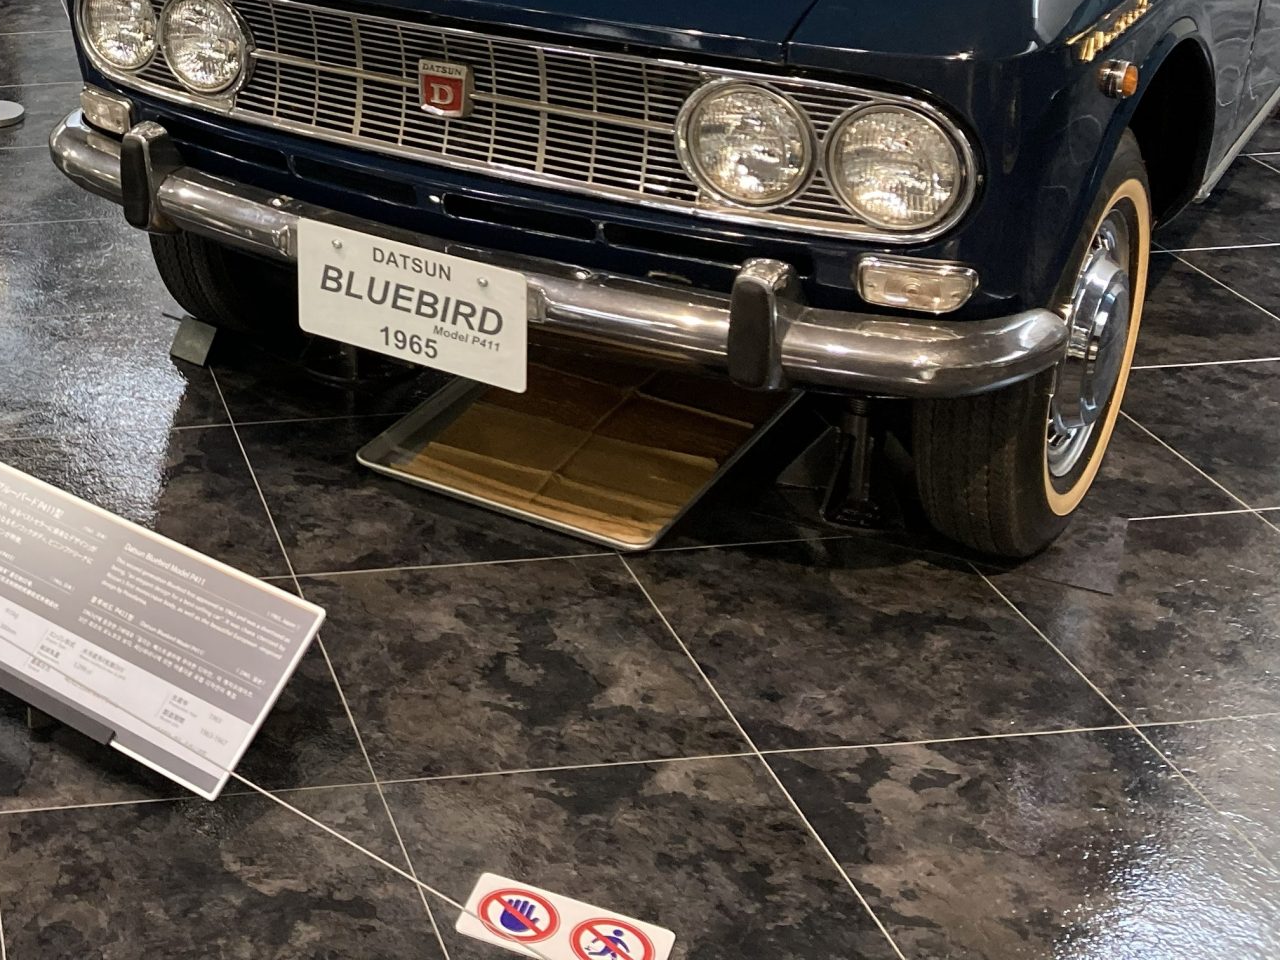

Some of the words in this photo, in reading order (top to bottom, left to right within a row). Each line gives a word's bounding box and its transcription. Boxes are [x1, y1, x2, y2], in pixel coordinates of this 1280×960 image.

[422, 62, 462, 76] DATSUN
[430, 83, 454, 105] D
[372, 247, 451, 281] DATSUN
[320, 264, 504, 336] BLUEBIRD
[379, 326, 438, 359] 1965
[433, 325, 468, 343] Model
[471, 336, 501, 352] P411
[122, 542, 147, 558] Datsun
[144, 552, 172, 570] Bluebird
[169, 564, 191, 579] Model
